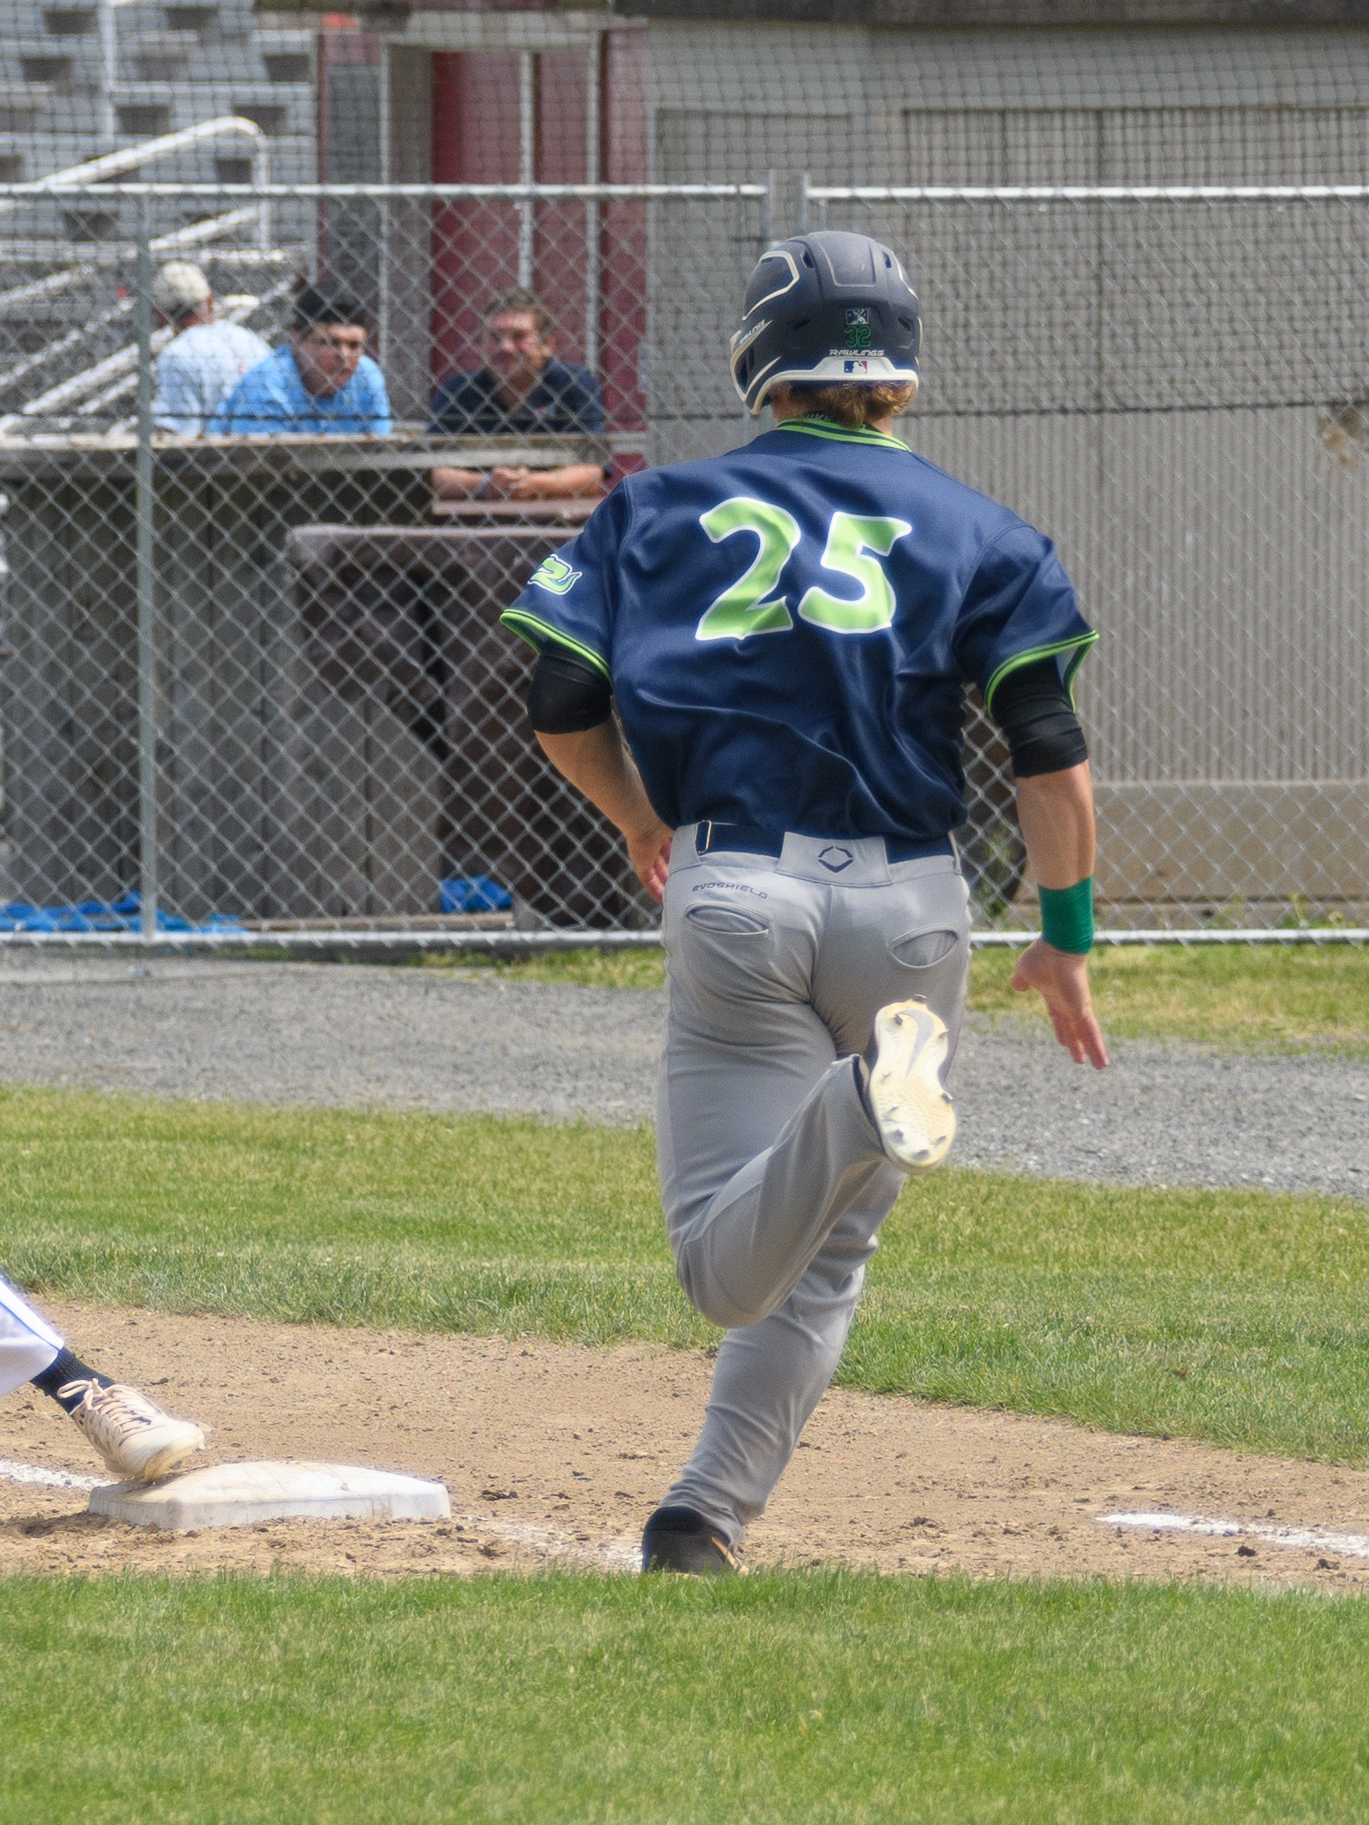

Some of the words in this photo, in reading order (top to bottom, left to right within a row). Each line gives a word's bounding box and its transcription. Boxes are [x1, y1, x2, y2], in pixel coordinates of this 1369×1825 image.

[844, 325, 872, 348] 32
[828, 349, 885, 357] RAWLINGS
[694, 496, 913, 642] 25
